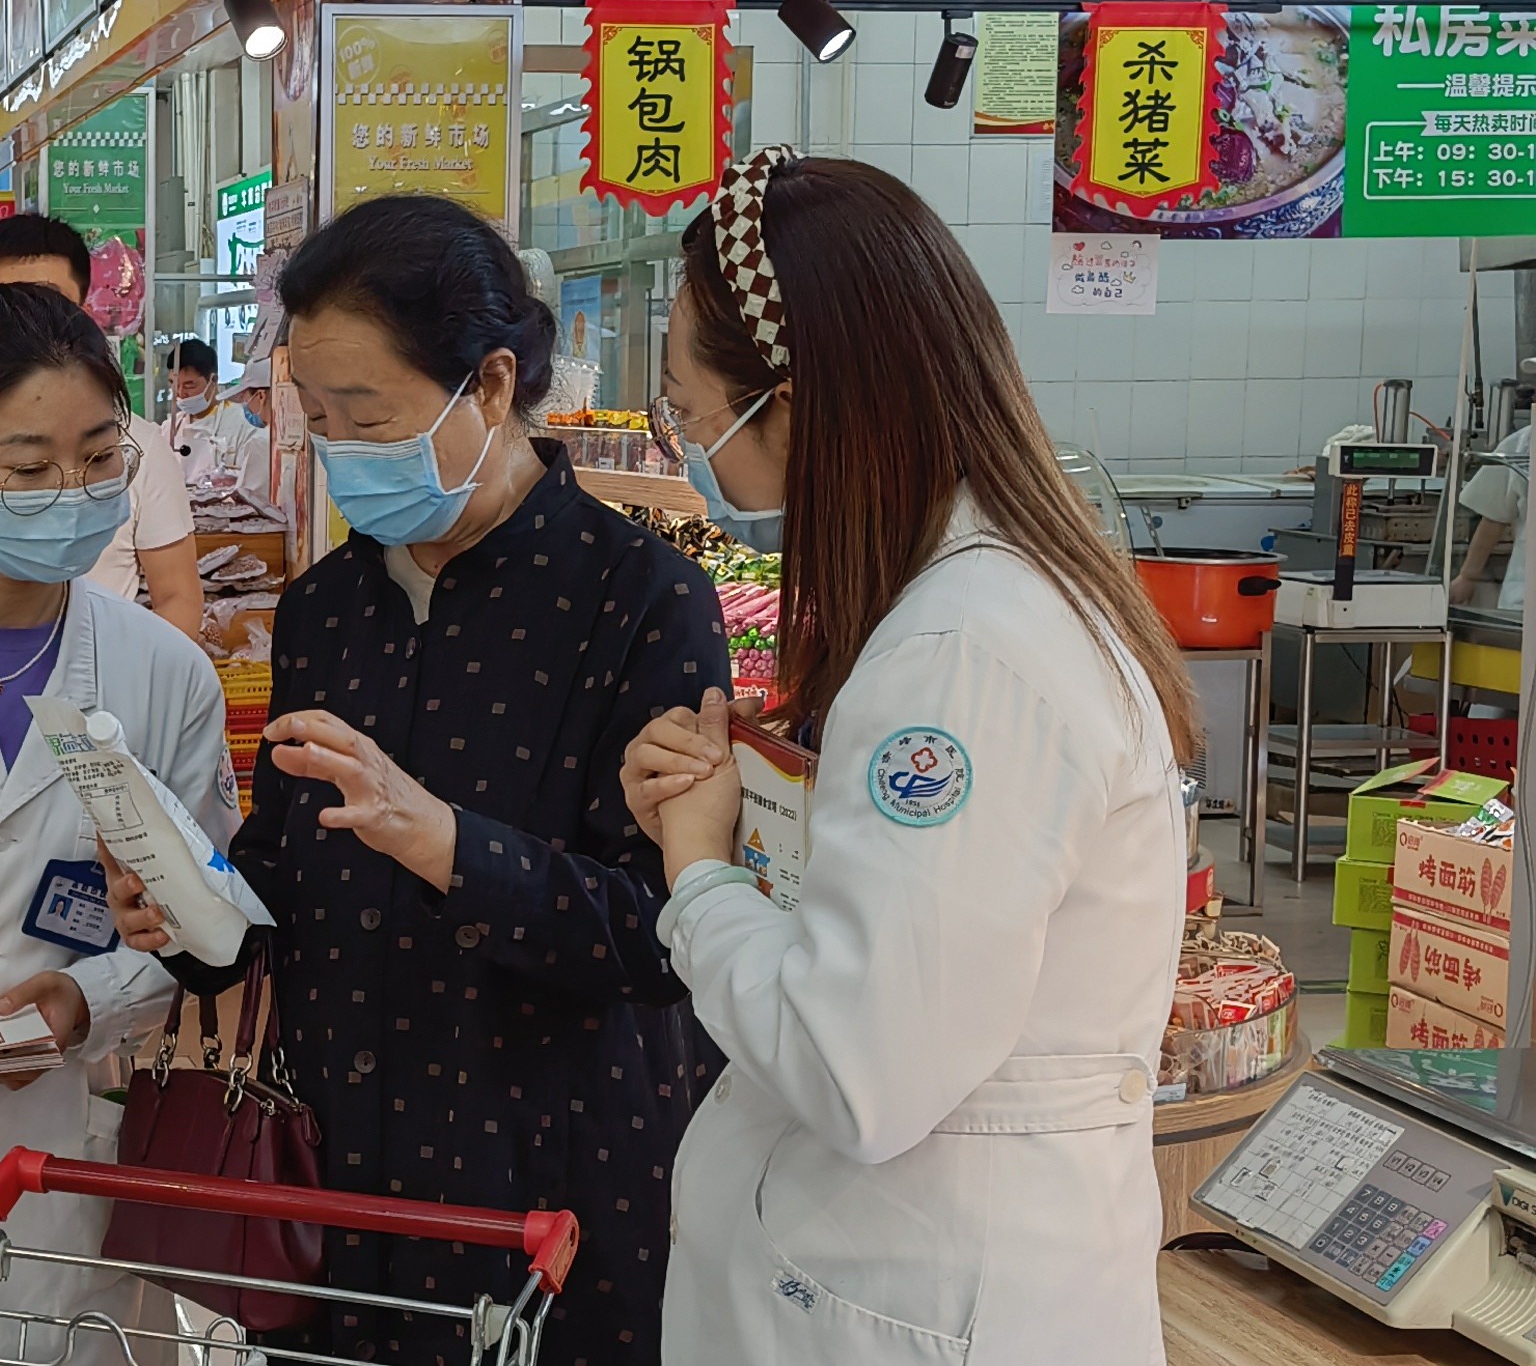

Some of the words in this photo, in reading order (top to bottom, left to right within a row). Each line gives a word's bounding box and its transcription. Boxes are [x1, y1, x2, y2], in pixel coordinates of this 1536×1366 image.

[627, 36, 688, 186] 锅包肉
[1118, 40, 1178, 185] 杀猪菜
[352, 122, 489, 149] 您的新鲜市场
[53, 160, 141, 178] 您的新鲜市场
[369, 156, 396, 170] Your
[399, 156, 429, 170] Fresh
[433, 156, 474, 170] Market
[63, 183, 81, 193] Your
[83, 183, 102, 193] Fresh
[104, 183, 129, 193] Market
[1093, 287, 1122, 298] 的自己
[1418, 854, 1476, 898] 烤面筋
[1425, 945, 1482, 991] 烤面筋
